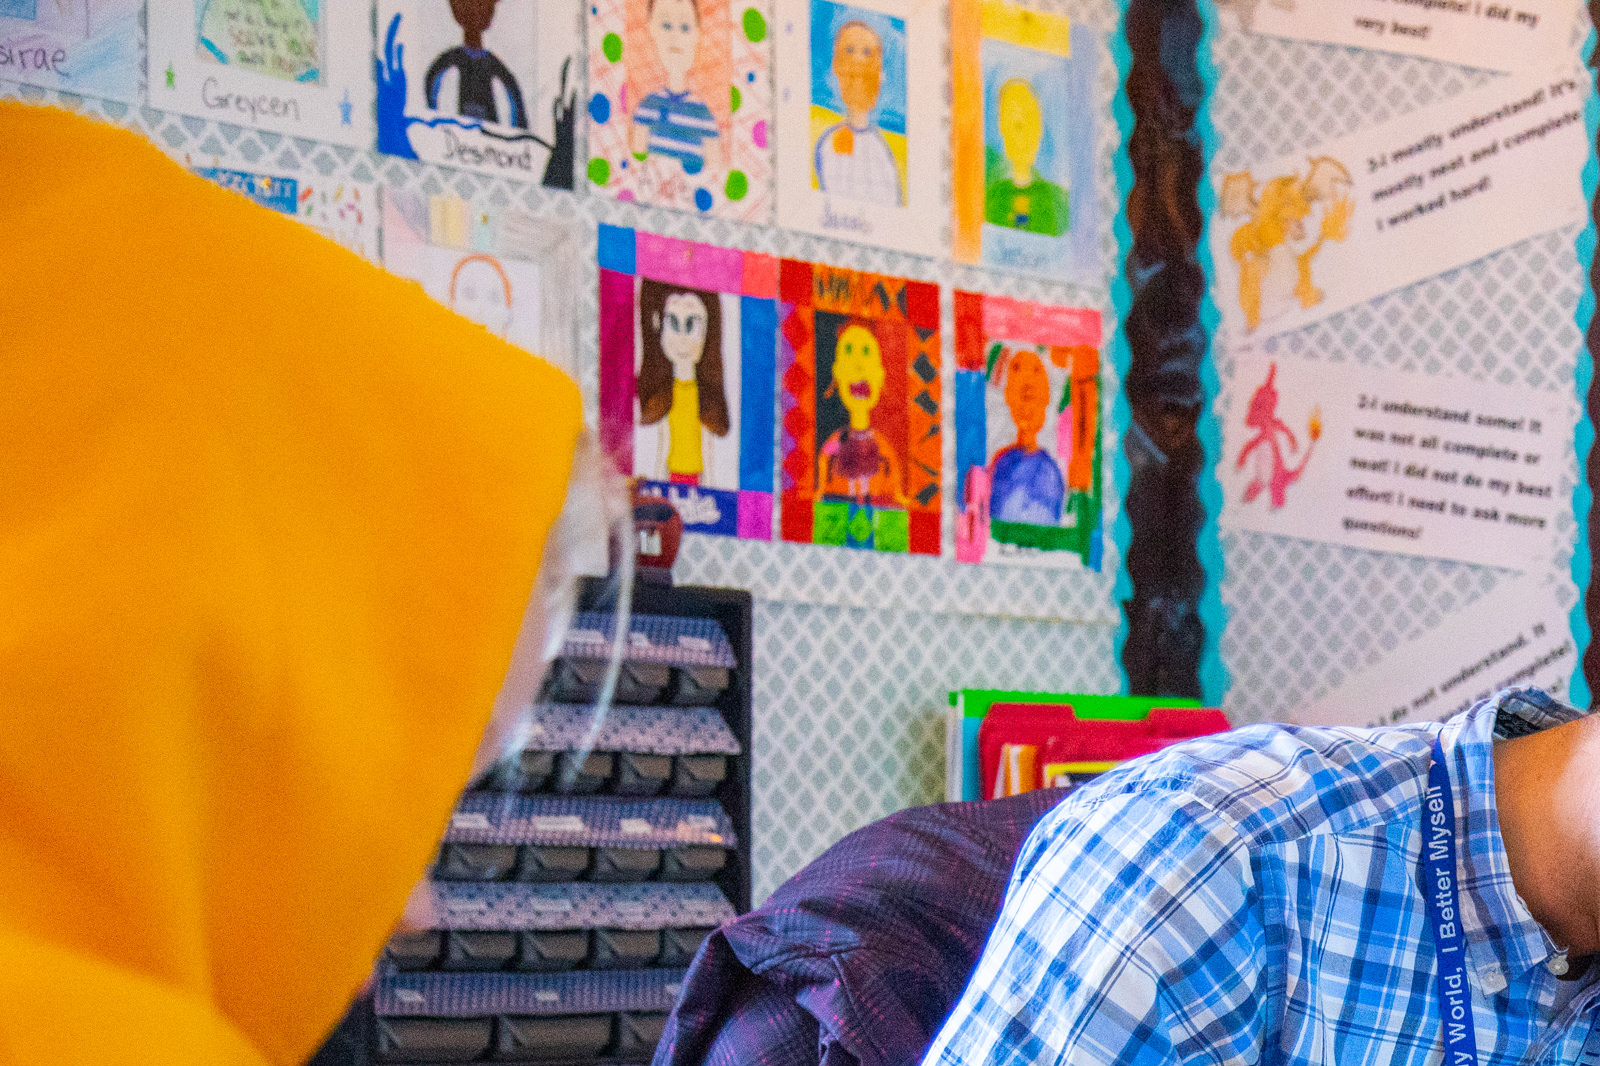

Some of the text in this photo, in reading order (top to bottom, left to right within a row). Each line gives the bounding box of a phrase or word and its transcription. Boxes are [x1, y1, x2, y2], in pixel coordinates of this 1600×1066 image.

[1355, 17, 1386, 34] very
[1485, 4, 1511, 21] did
[1515, 10, 1540, 28] my
[1392, 134, 1442, 162] mostly
[1449, 88, 1544, 138] understand!
[1372, 173, 1423, 200] mostly
[1430, 155, 1464, 178] neat
[1471, 141, 1498, 162] and
[1388, 193, 1446, 226] worked
[1381, 401, 1470, 424] understand
[1529, 418, 1542, 434] It
[1354, 428, 1541, 464] was not all complete or
[1404, 463, 1428, 479] did
[1432, 469, 1459, 483] not
[1462, 472, 1482, 487] do
[1488, 478, 1511, 495] my
[1516, 480, 1552, 497] best
[1408, 497, 1446, 513] need
[1451, 501, 1467, 516] to
[1473, 506, 1499, 521] ask
[1506, 512, 1547, 529] more
[1412, 686, 1436, 709] not
[1436, 867, 1457, 939] Better
[1442, 945, 1458, 953] I
[1444, 966, 1466, 1045] World,
